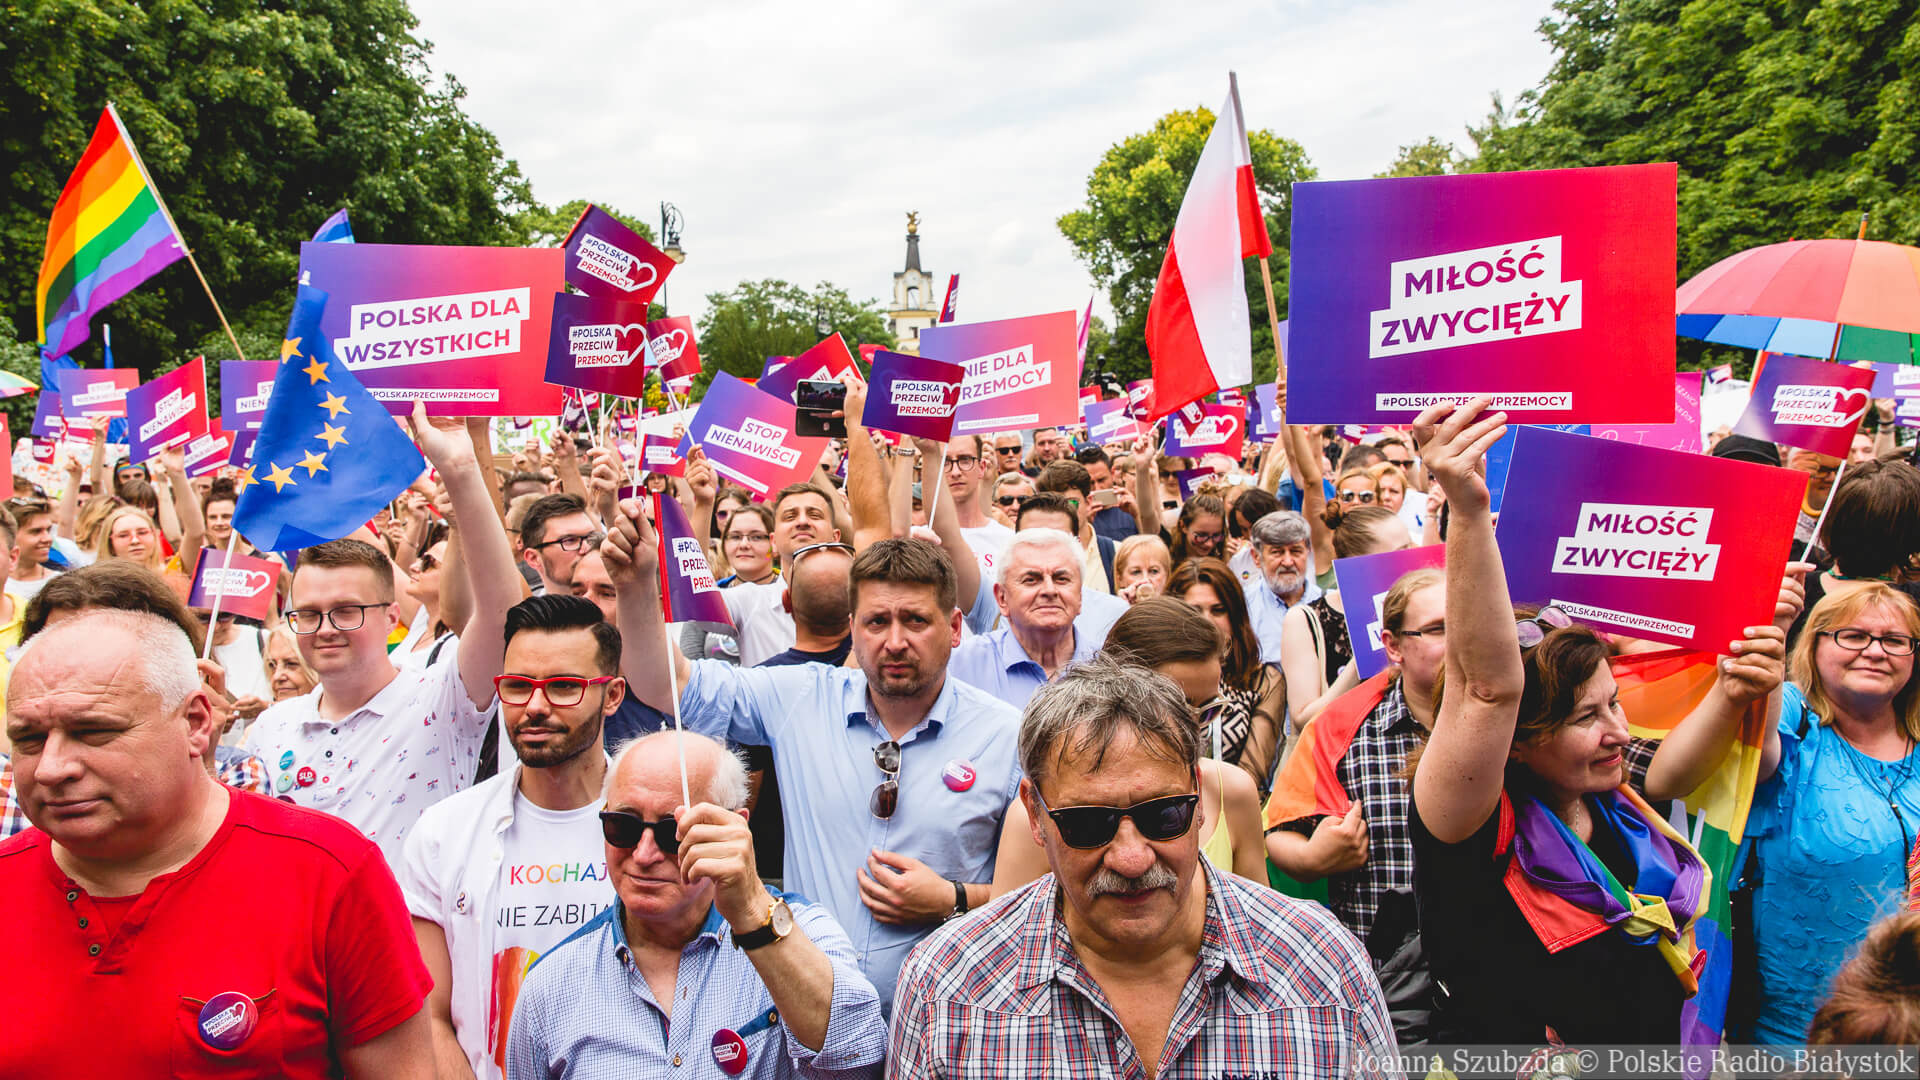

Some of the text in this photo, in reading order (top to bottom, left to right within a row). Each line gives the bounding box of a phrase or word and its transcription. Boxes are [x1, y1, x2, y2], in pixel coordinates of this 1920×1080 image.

[580, 247, 627, 273] PRZECIW
[584, 237, 629, 264] #POLSKA
[580, 260, 631, 289] PRZEMOCY
[1404, 244, 1545, 298] MIŁOŚĆ
[360, 296, 521, 331] POLSKA DLA
[1380, 291, 1570, 347] ZWYCIĘŻY
[572, 327, 613, 338] #POLSKA
[343, 328, 511, 364] WSZYSTKICH
[572, 340, 614, 351] PRZECIW
[577, 354, 625, 365] PRZEMOCY
[993, 351, 1027, 370] DLA
[895, 382, 940, 392] #POLSKA
[962, 367, 1046, 401] RZEMOCY
[1779, 387, 1831, 398] #POLSKA
[369, 391, 495, 400] POLSKAPRZECIWPRZEMOCY
[895, 393, 941, 403] PRZECIW
[1775, 400, 1832, 410] PRZECIW
[899, 405, 949, 416] PRZEMOCY
[1777, 413, 1841, 424] PRZEMOCY
[745, 422, 782, 441] STOP
[710, 429, 795, 464] NIENAWIŚCI
[1588, 510, 1699, 537] MIŁOŚĆ
[1561, 546, 1710, 576] ZWYCIĘŻY
[1560, 603, 1691, 635] POLSKAPRZECIWPRZEMOCY
[298, 770, 313, 781] SLD
[510, 862, 608, 885] KOCHAJ
